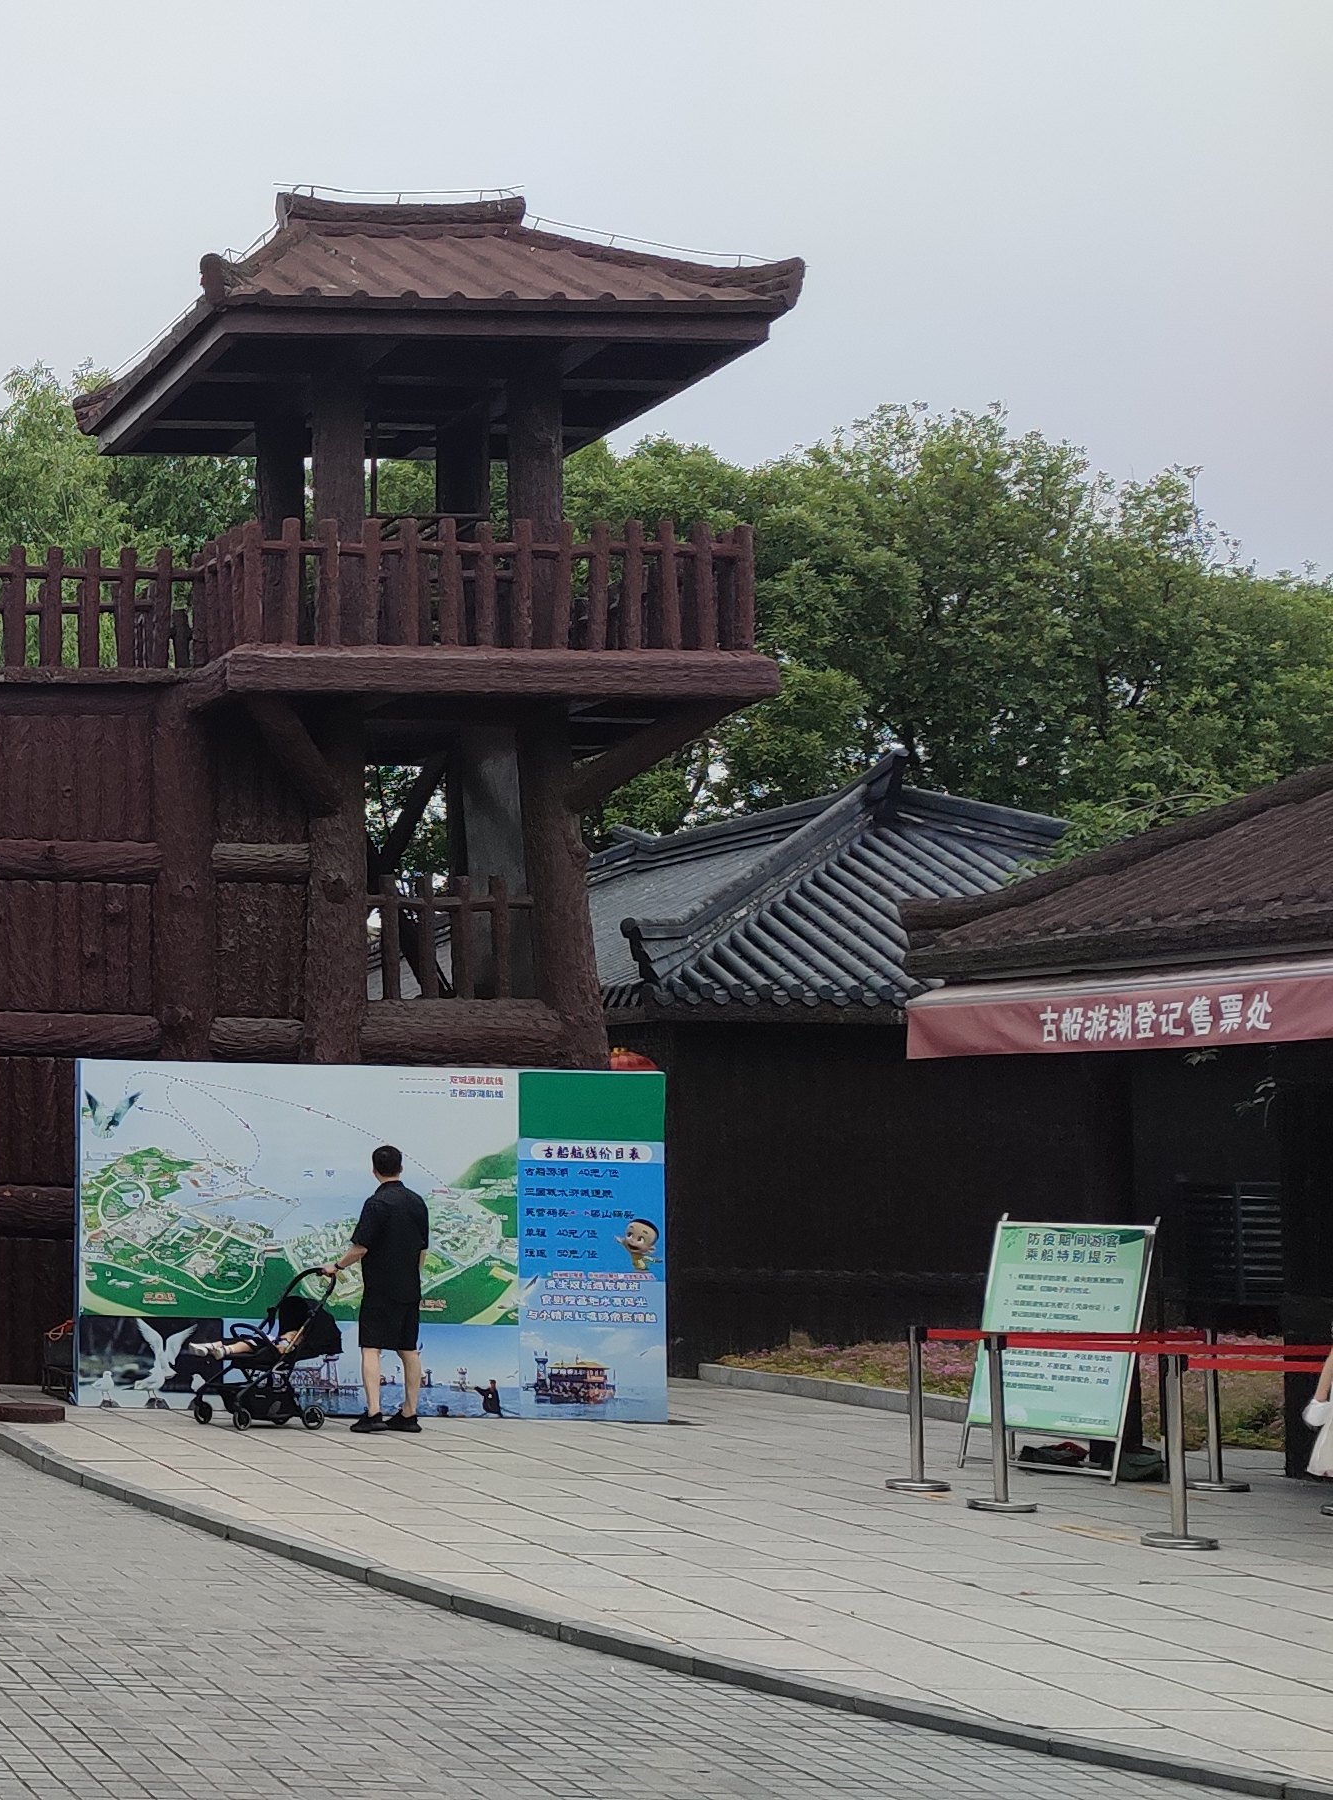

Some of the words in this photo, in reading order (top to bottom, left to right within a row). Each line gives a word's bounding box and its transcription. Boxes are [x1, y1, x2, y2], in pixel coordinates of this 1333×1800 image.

[1039, 990, 1273, 1043] 古船游湖登记售票处
[541, 1145, 641, 1161] 古船航线价目表
[1026, 1232, 1121, 1248] 防疫期间游客
[1024, 1248, 1118, 1264] 乘船特别提示
